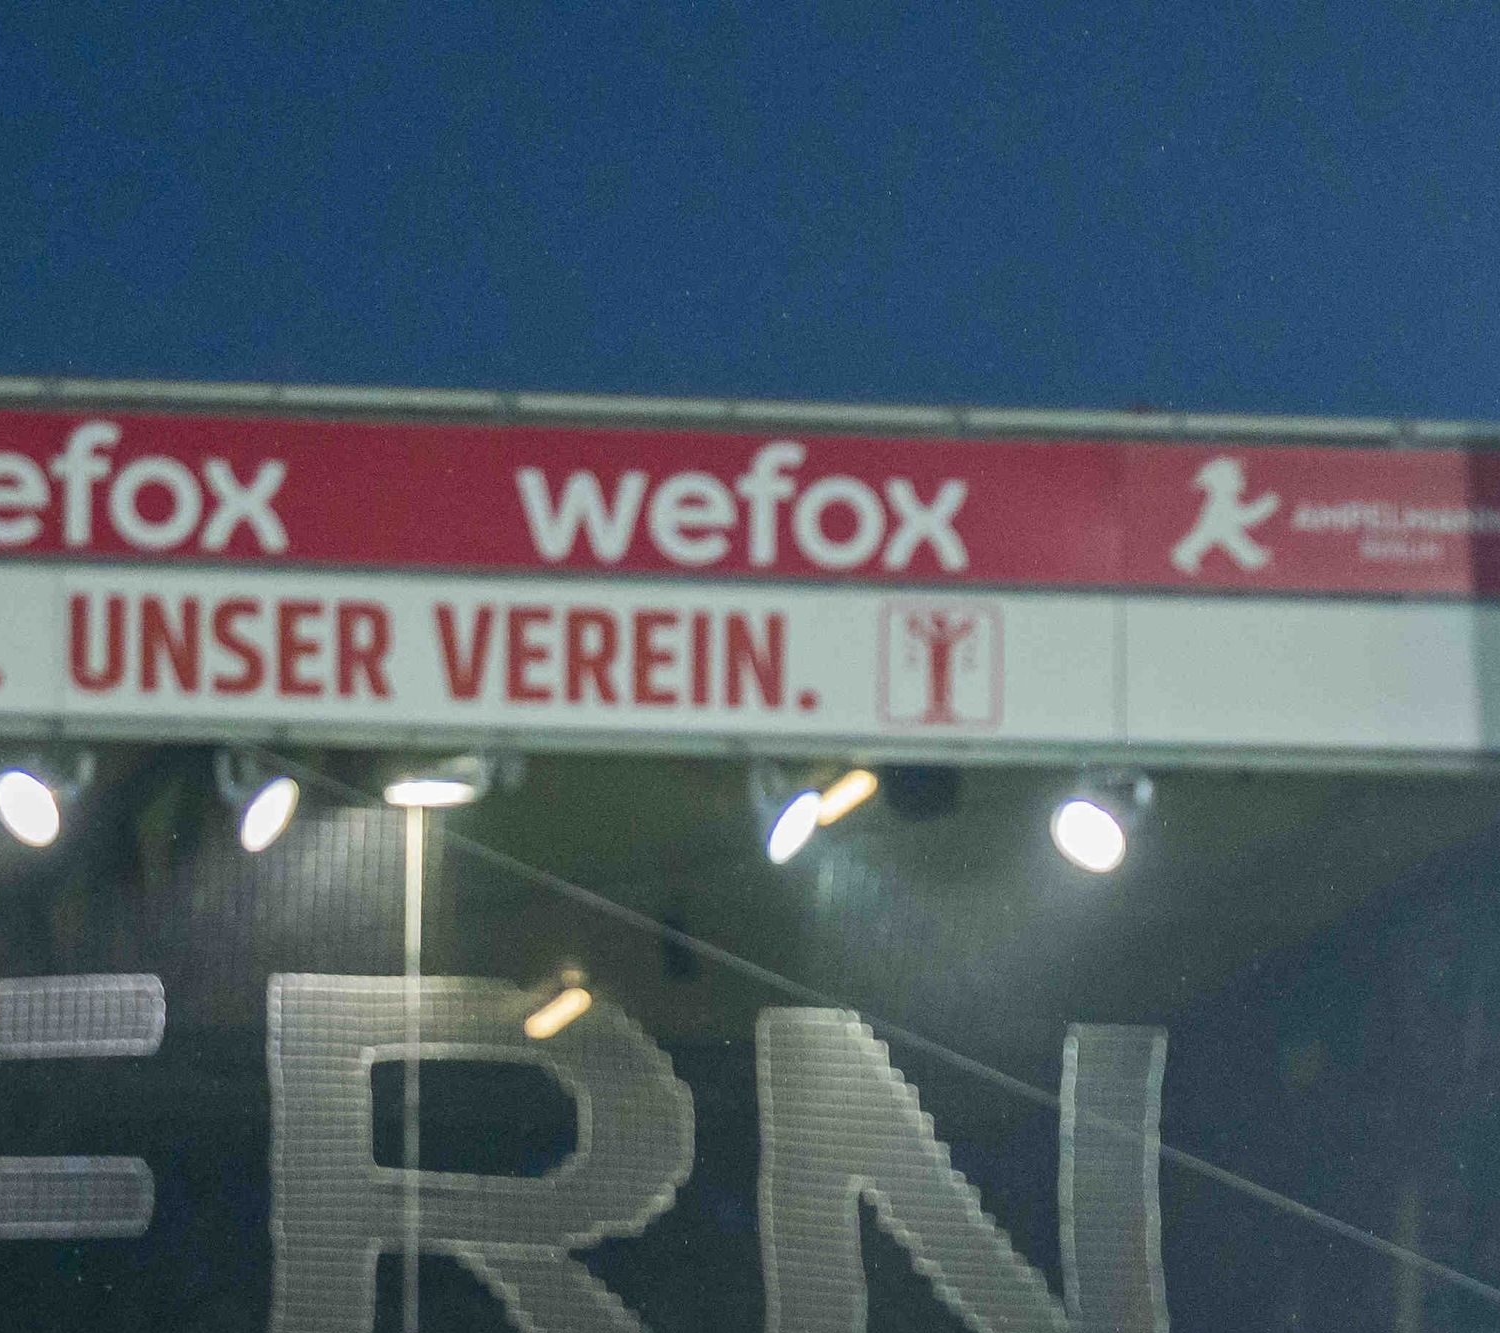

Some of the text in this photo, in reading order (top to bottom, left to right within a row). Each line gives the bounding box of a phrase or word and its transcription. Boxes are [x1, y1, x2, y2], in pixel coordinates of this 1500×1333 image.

[516, 441, 969, 572] wefox
[68, 595, 391, 698] UNSER
[436, 606, 820, 714] VEREIN.
